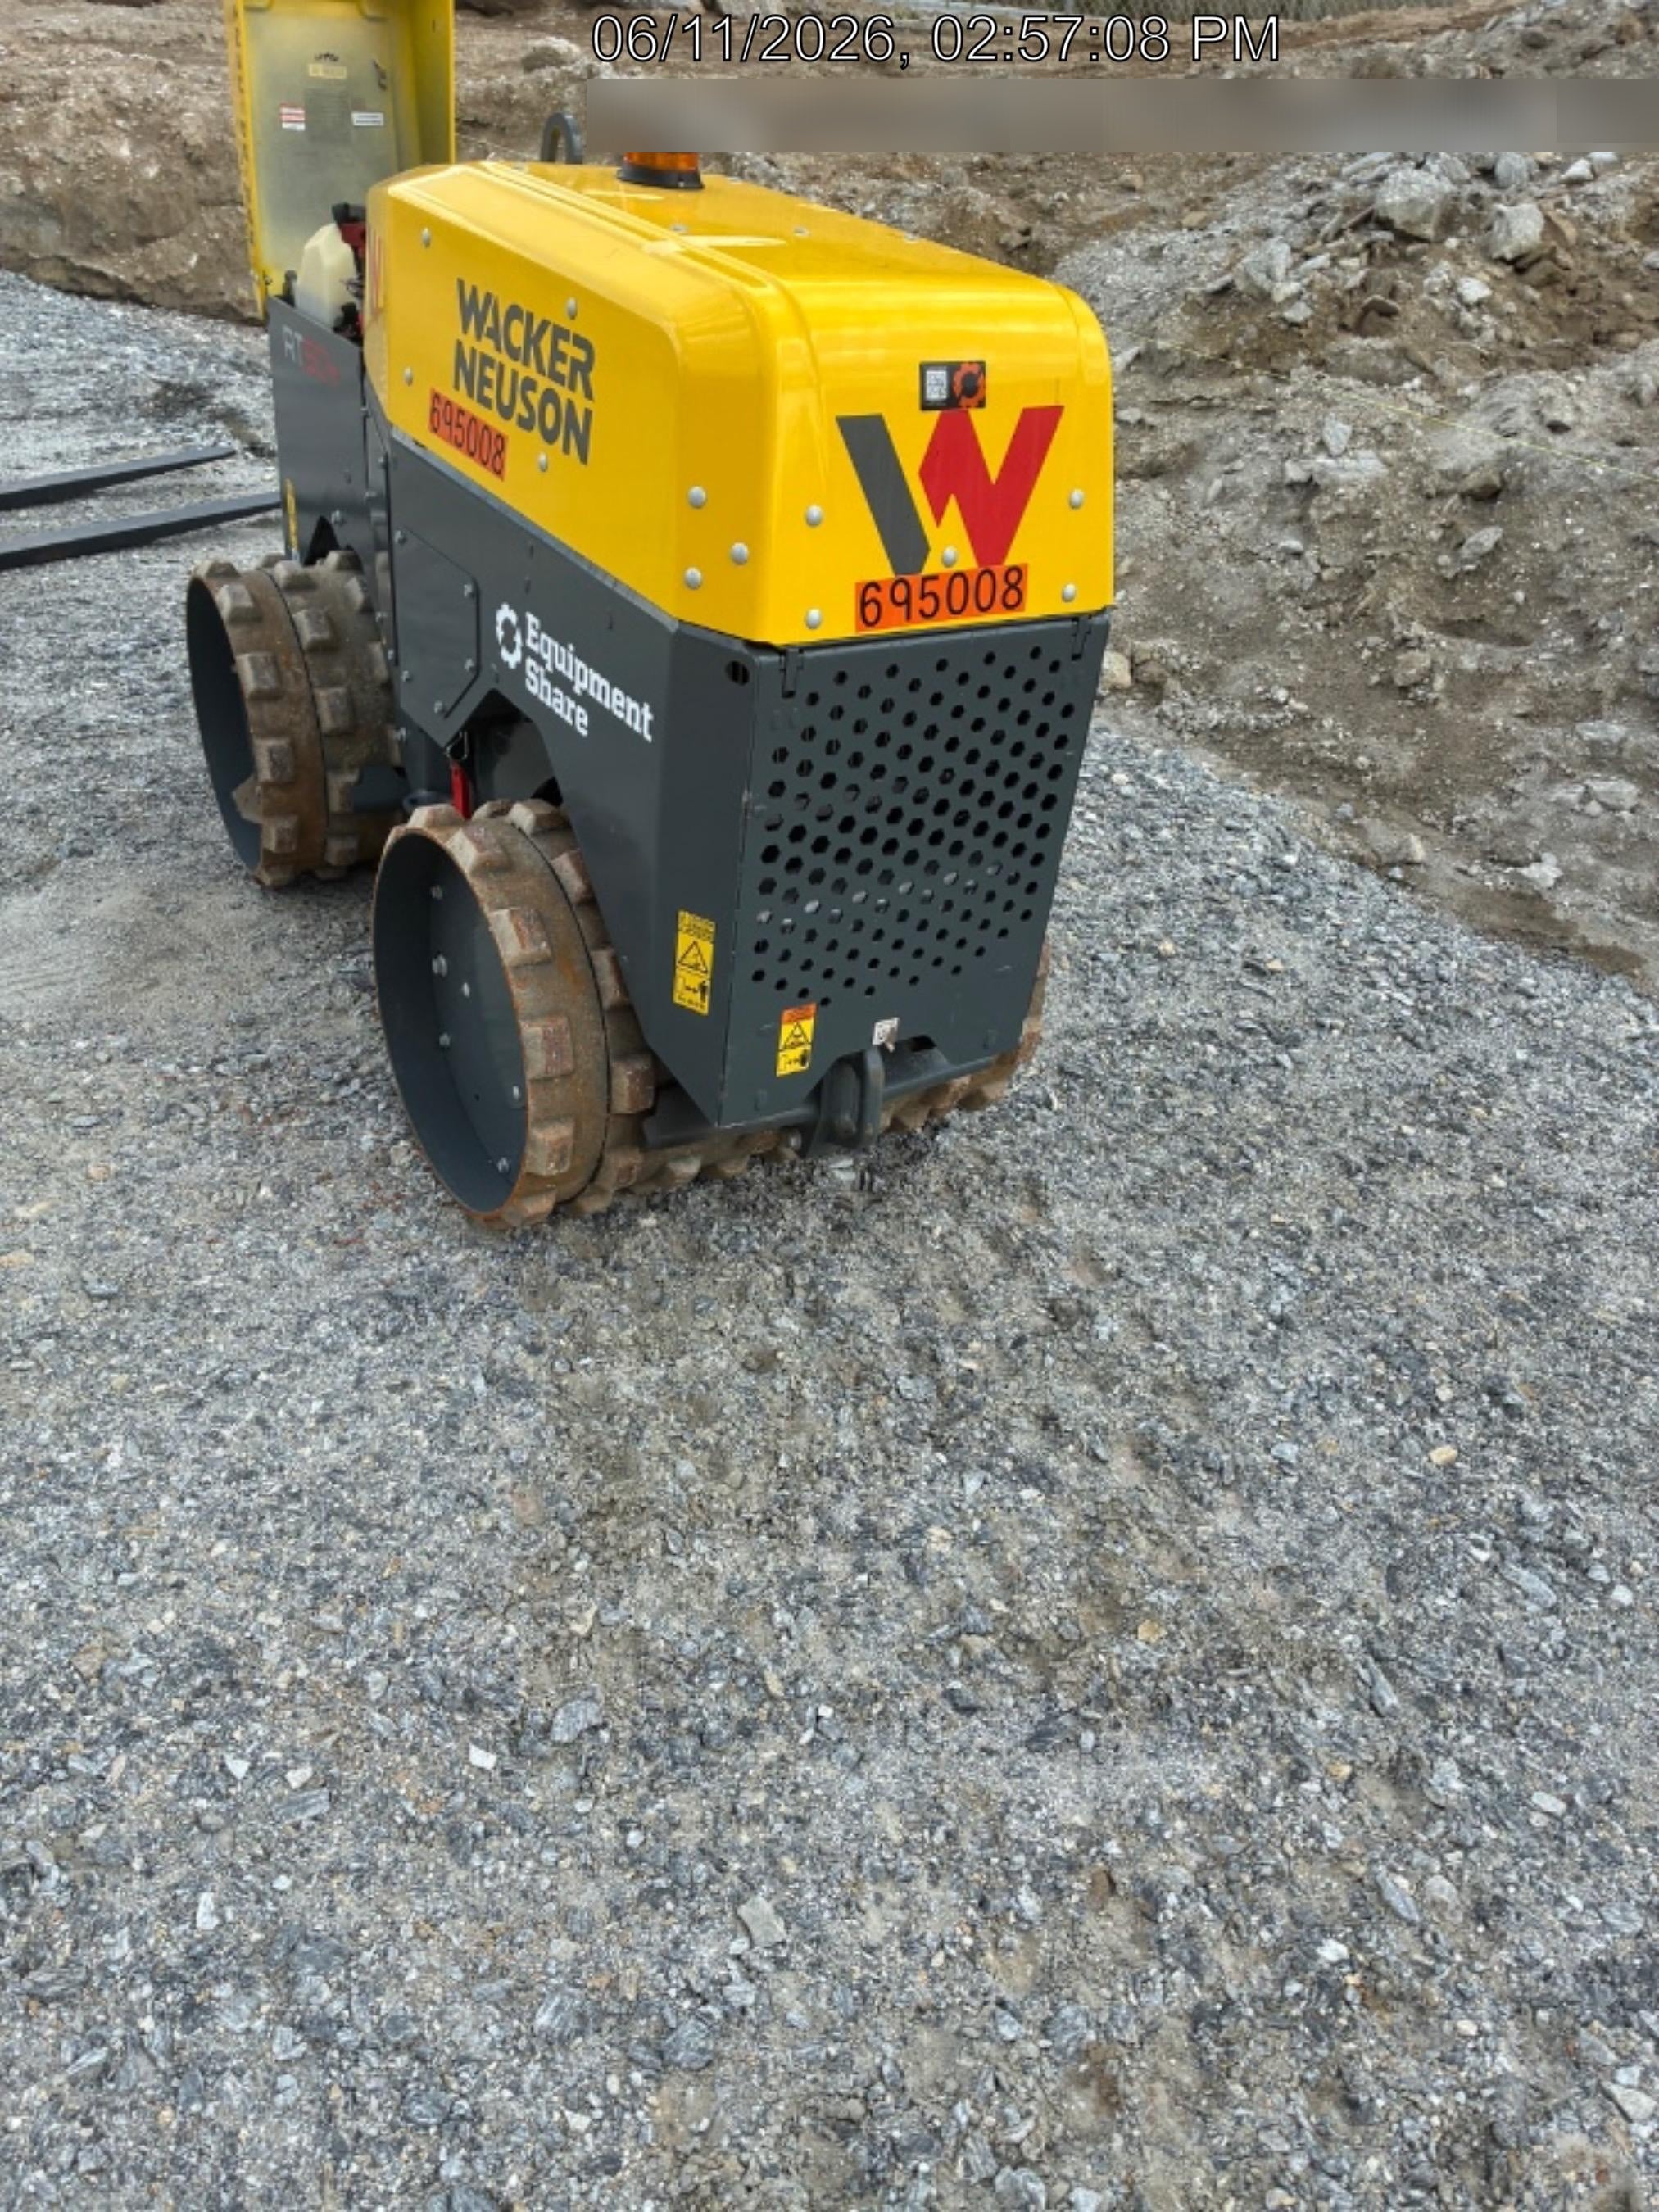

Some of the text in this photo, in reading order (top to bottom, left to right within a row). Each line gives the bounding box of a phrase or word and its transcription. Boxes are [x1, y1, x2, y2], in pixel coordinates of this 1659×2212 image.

[456, 277, 595, 401] WACKER
[428, 392, 505, 476] 695008
[454, 339, 593, 465] NEUSON
[859, 565, 1025, 628] 695008
[524, 656, 589, 737] Share
[525, 611, 655, 743] Equipment
